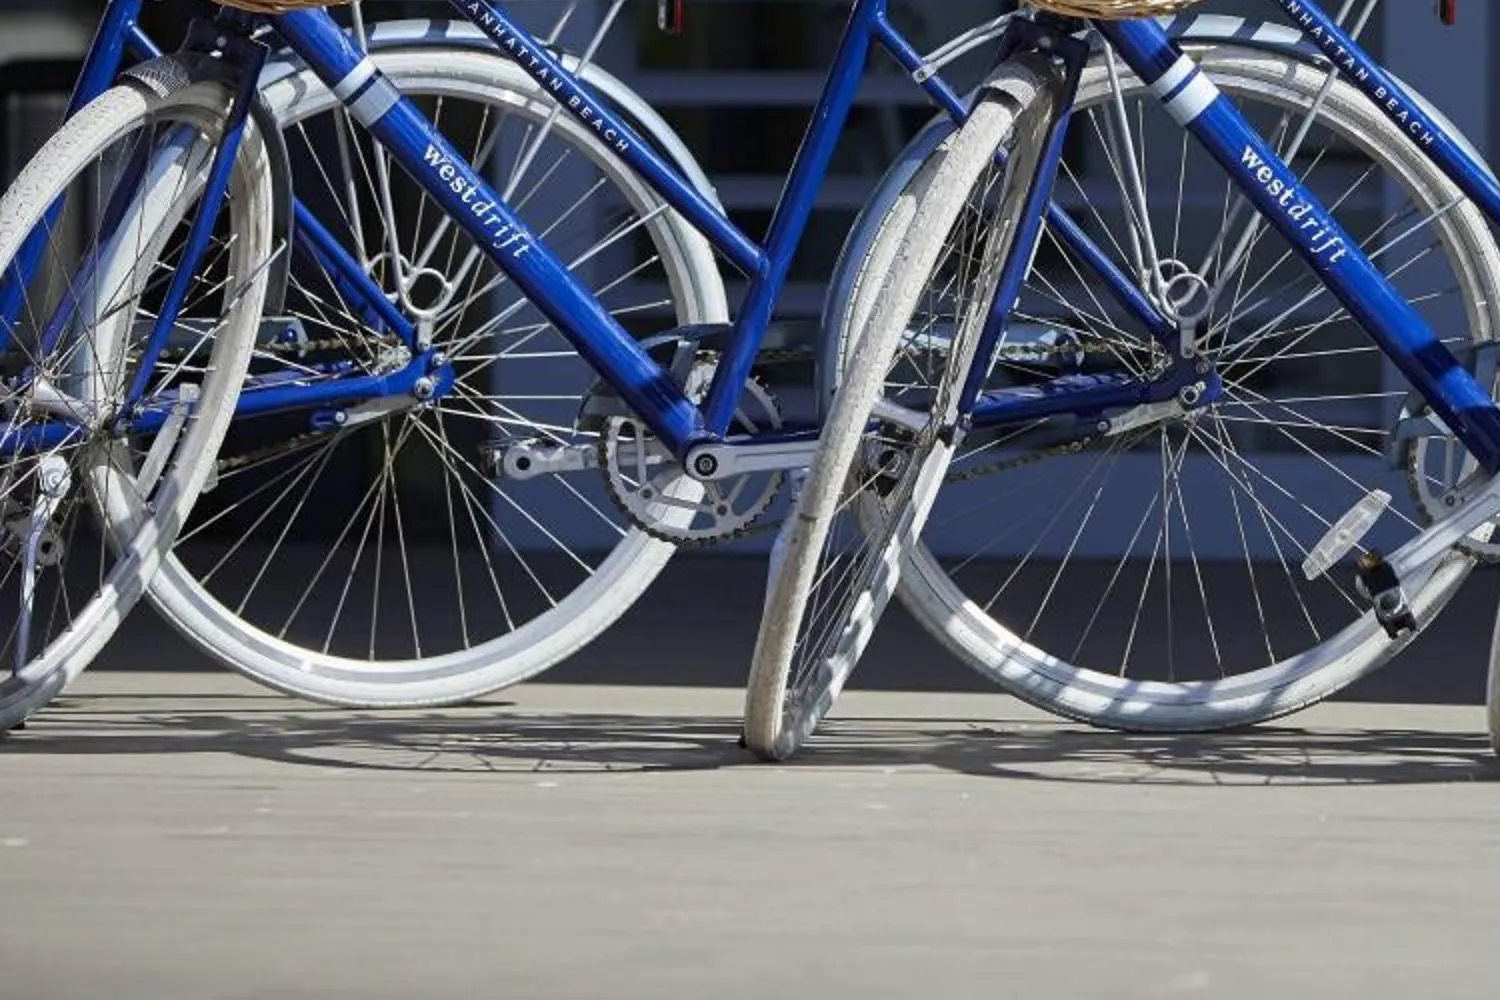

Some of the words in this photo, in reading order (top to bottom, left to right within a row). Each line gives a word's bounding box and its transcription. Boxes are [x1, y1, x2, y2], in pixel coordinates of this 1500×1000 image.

[568, 95, 629, 152] BEACH
[1374, 87, 1434, 147] BEACH
[424, 143, 532, 259] westdrift
[1240, 145, 1349, 264] westdrift
